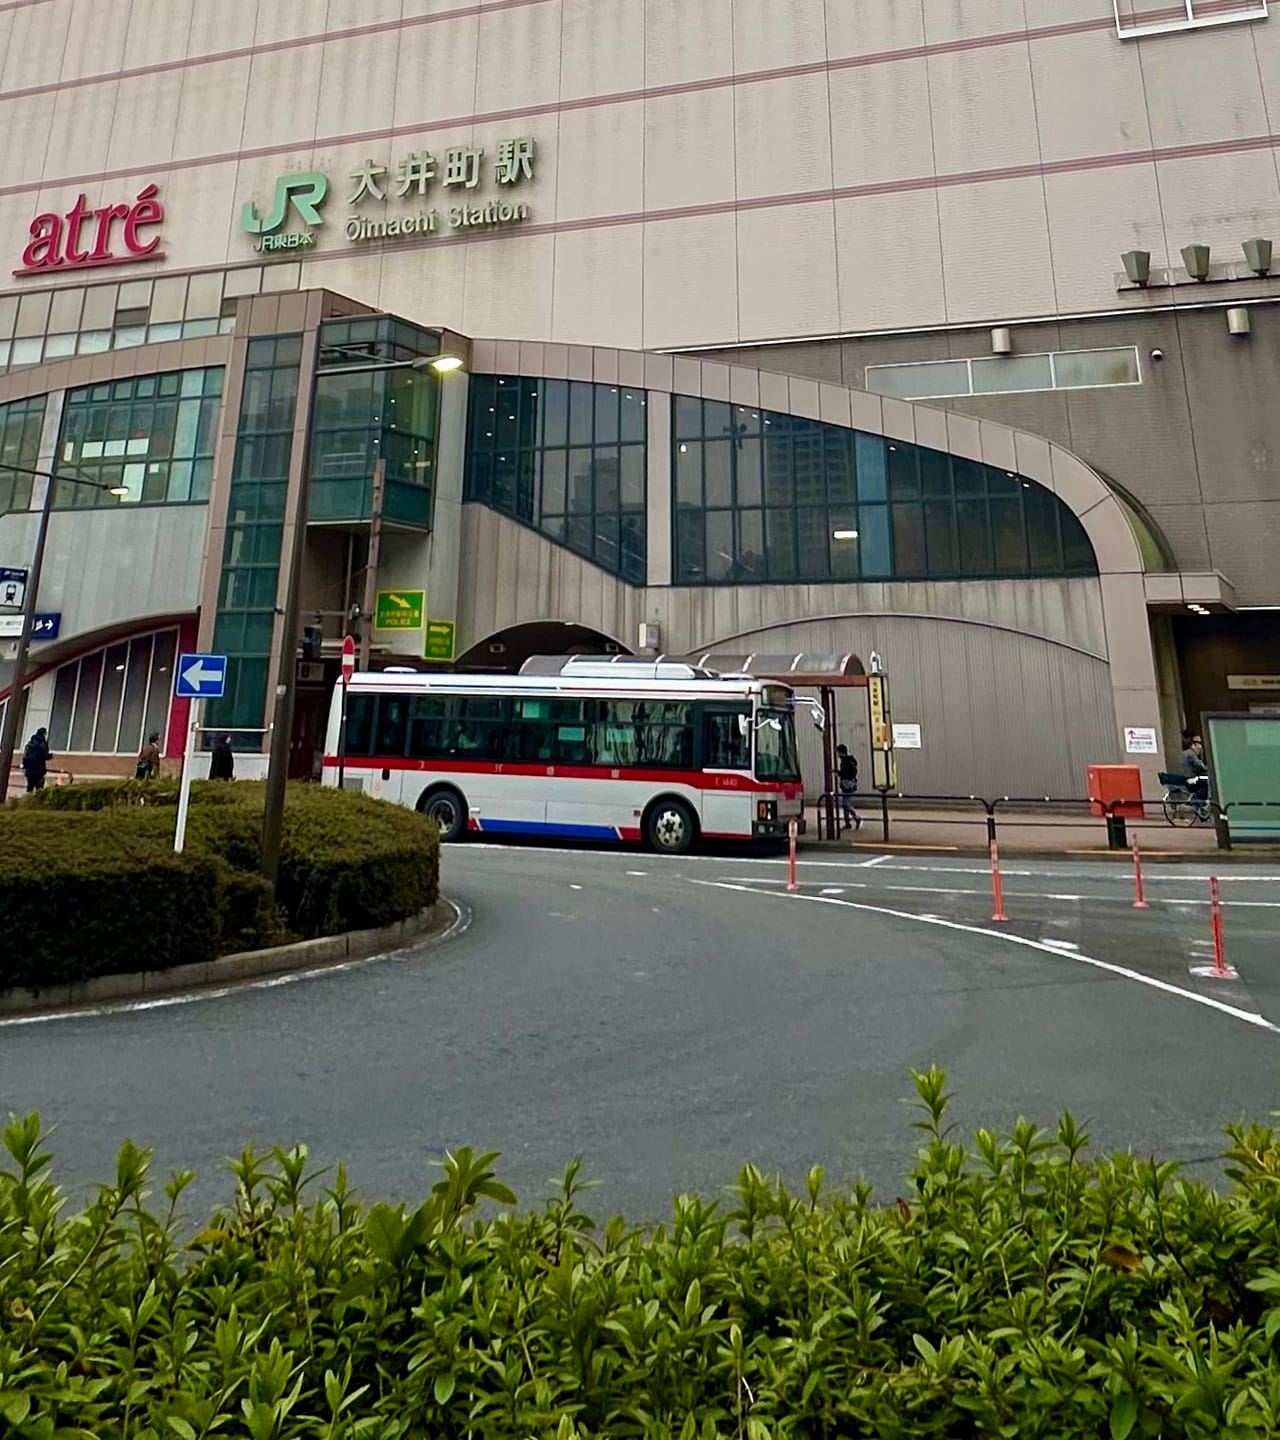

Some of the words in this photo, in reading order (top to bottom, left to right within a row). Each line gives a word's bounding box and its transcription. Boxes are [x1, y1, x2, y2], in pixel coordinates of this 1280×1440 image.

[348, 137, 535, 204] 大井町駅
[21, 184, 164, 268] atré
[241, 171, 327, 234] JR
[344, 206, 436, 241] Ōimachi
[447, 199, 529, 228] Station
[251, 230, 314, 252] JR東日本
